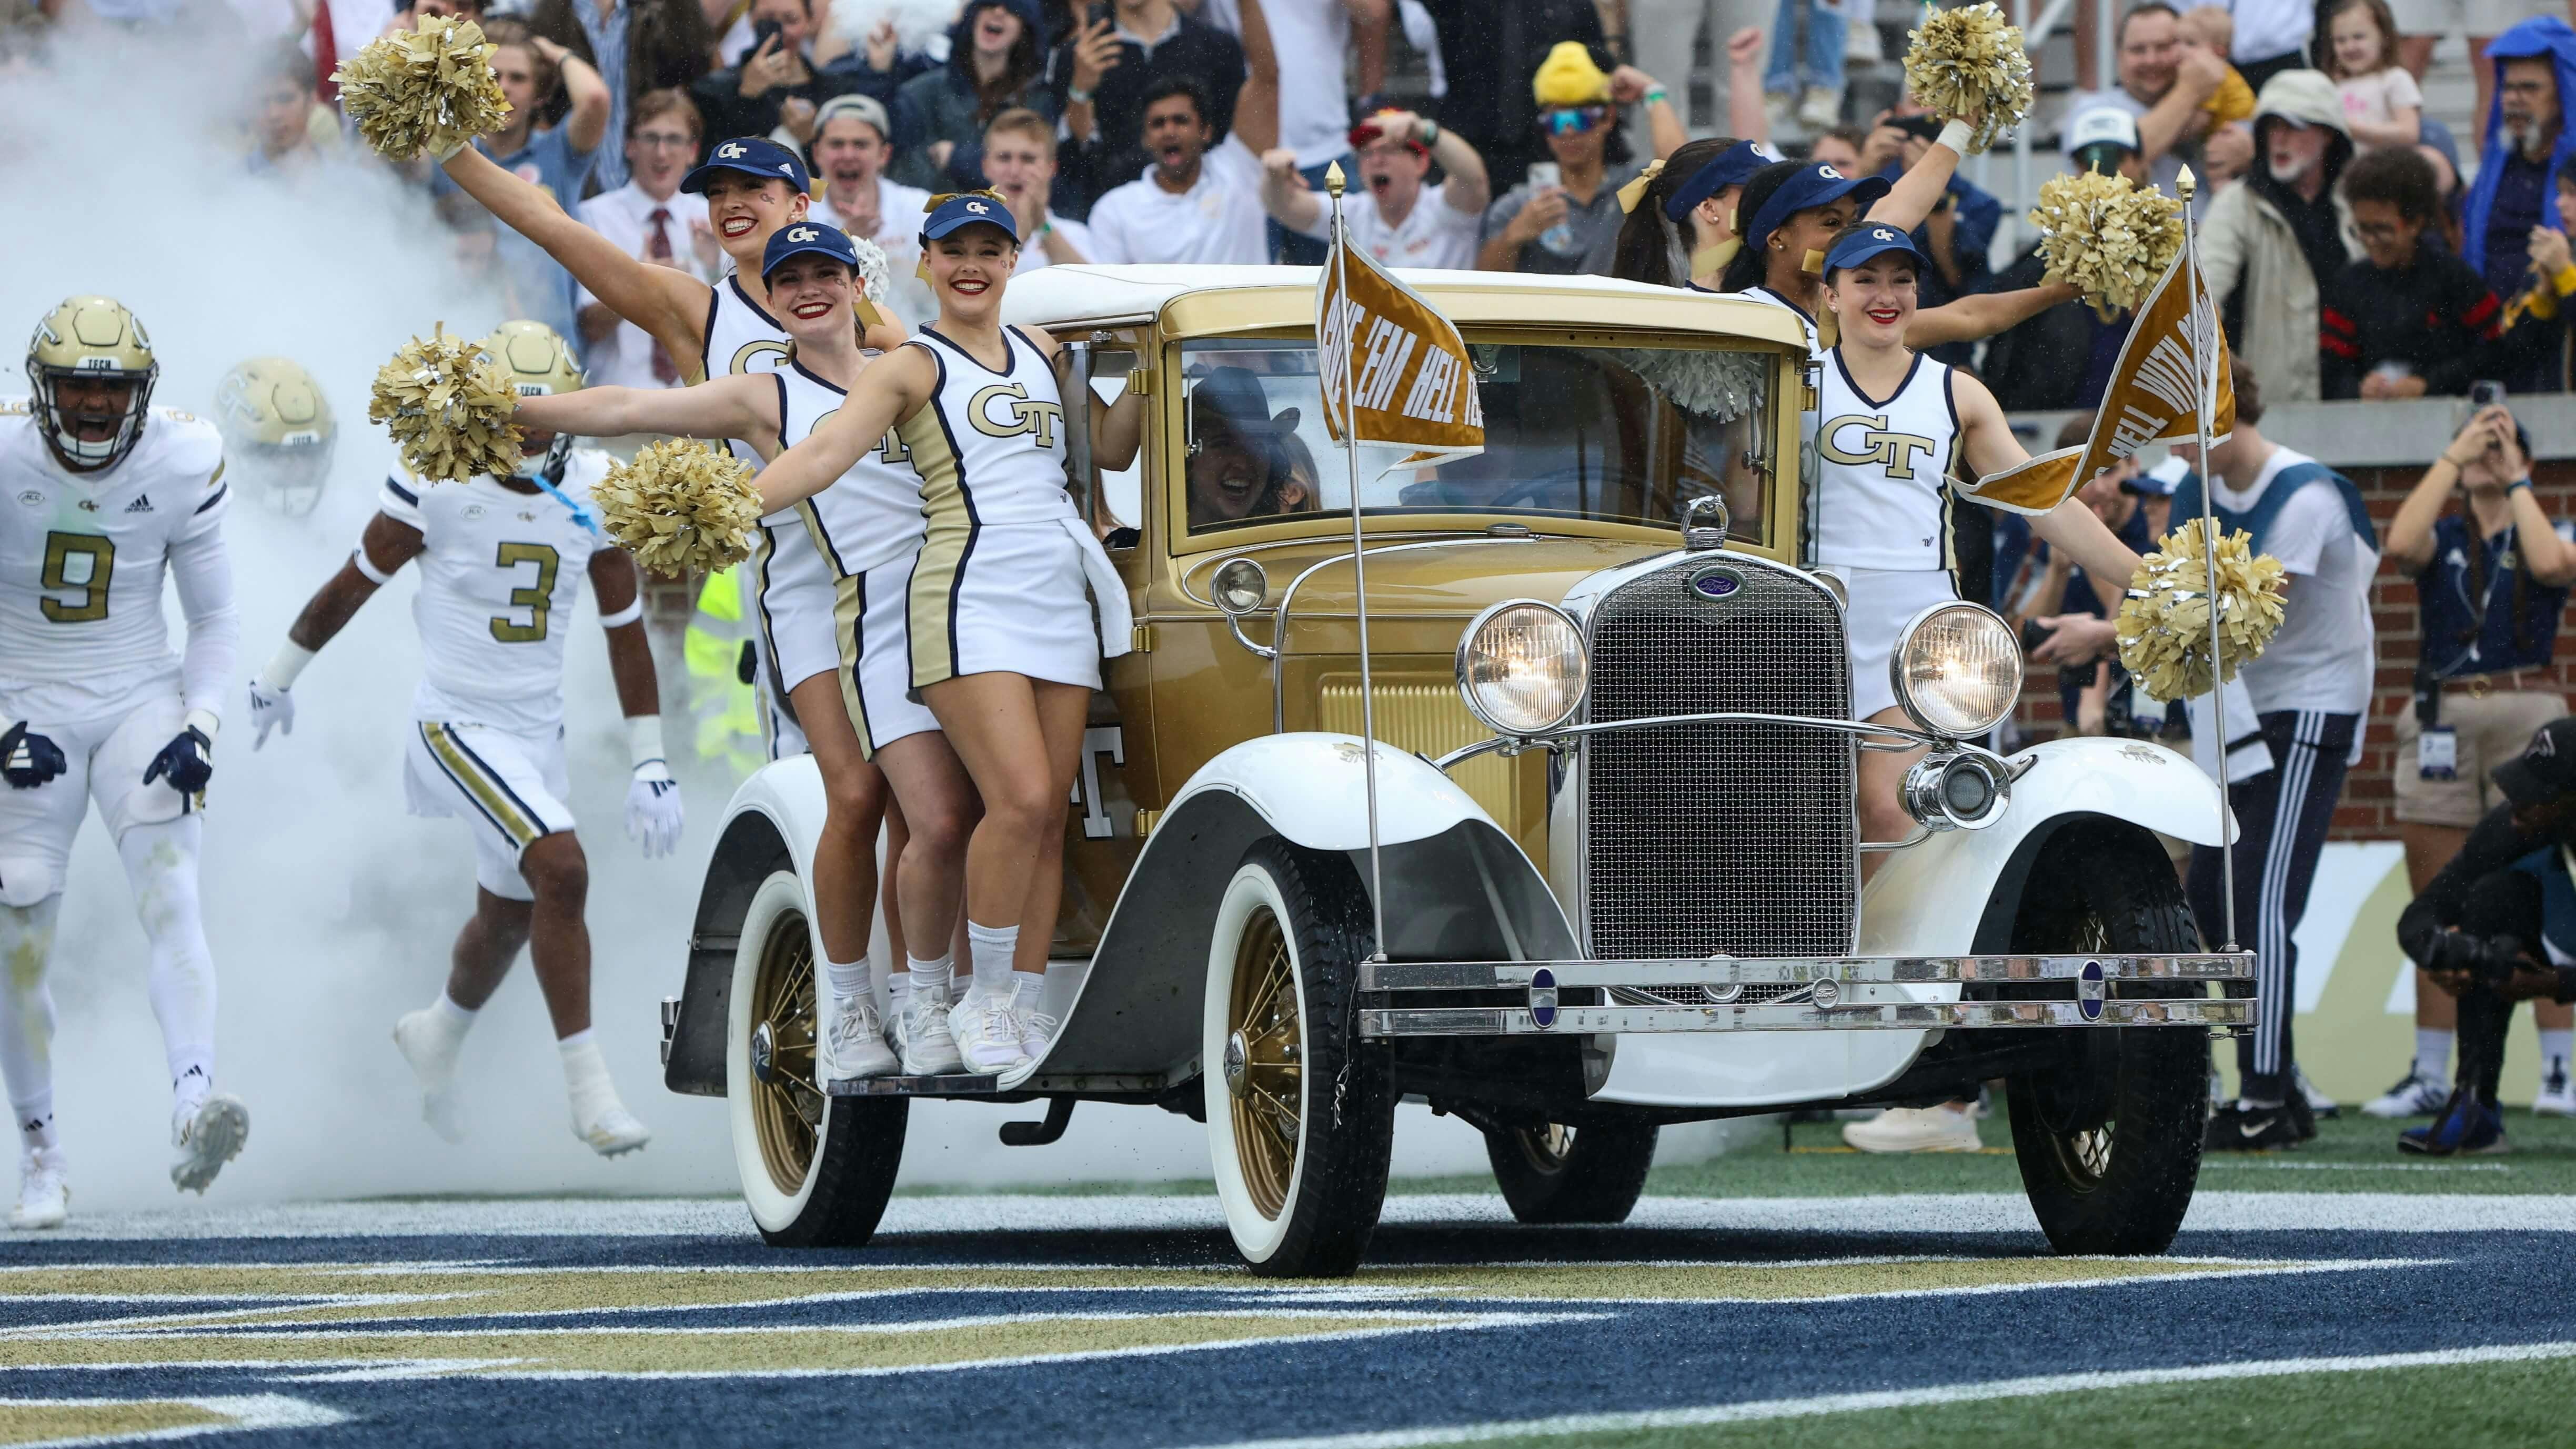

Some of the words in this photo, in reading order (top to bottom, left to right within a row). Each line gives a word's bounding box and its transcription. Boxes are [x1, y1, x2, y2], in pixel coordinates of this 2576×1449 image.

[718, 143, 747, 159] GT
[966, 202, 989, 215] GT
[787, 227, 819, 243] GT
[1873, 228, 1894, 241] GT
[87, 359, 112, 369] TECH
[1353, 315, 1418, 412] 'EM
[1402, 344, 1462, 424] HELL
[2131, 334, 2197, 416] WITH
[520, 386, 542, 396] TECH
[968, 382, 1064, 449] GT
[2107, 404, 2168, 459] HELL
[1814, 414, 1936, 480] GT
[78, 500, 99, 512] GT
[40, 530, 115, 623] 9
[489, 541, 560, 643] 3
[1699, 579, 1730, 591] Ford
